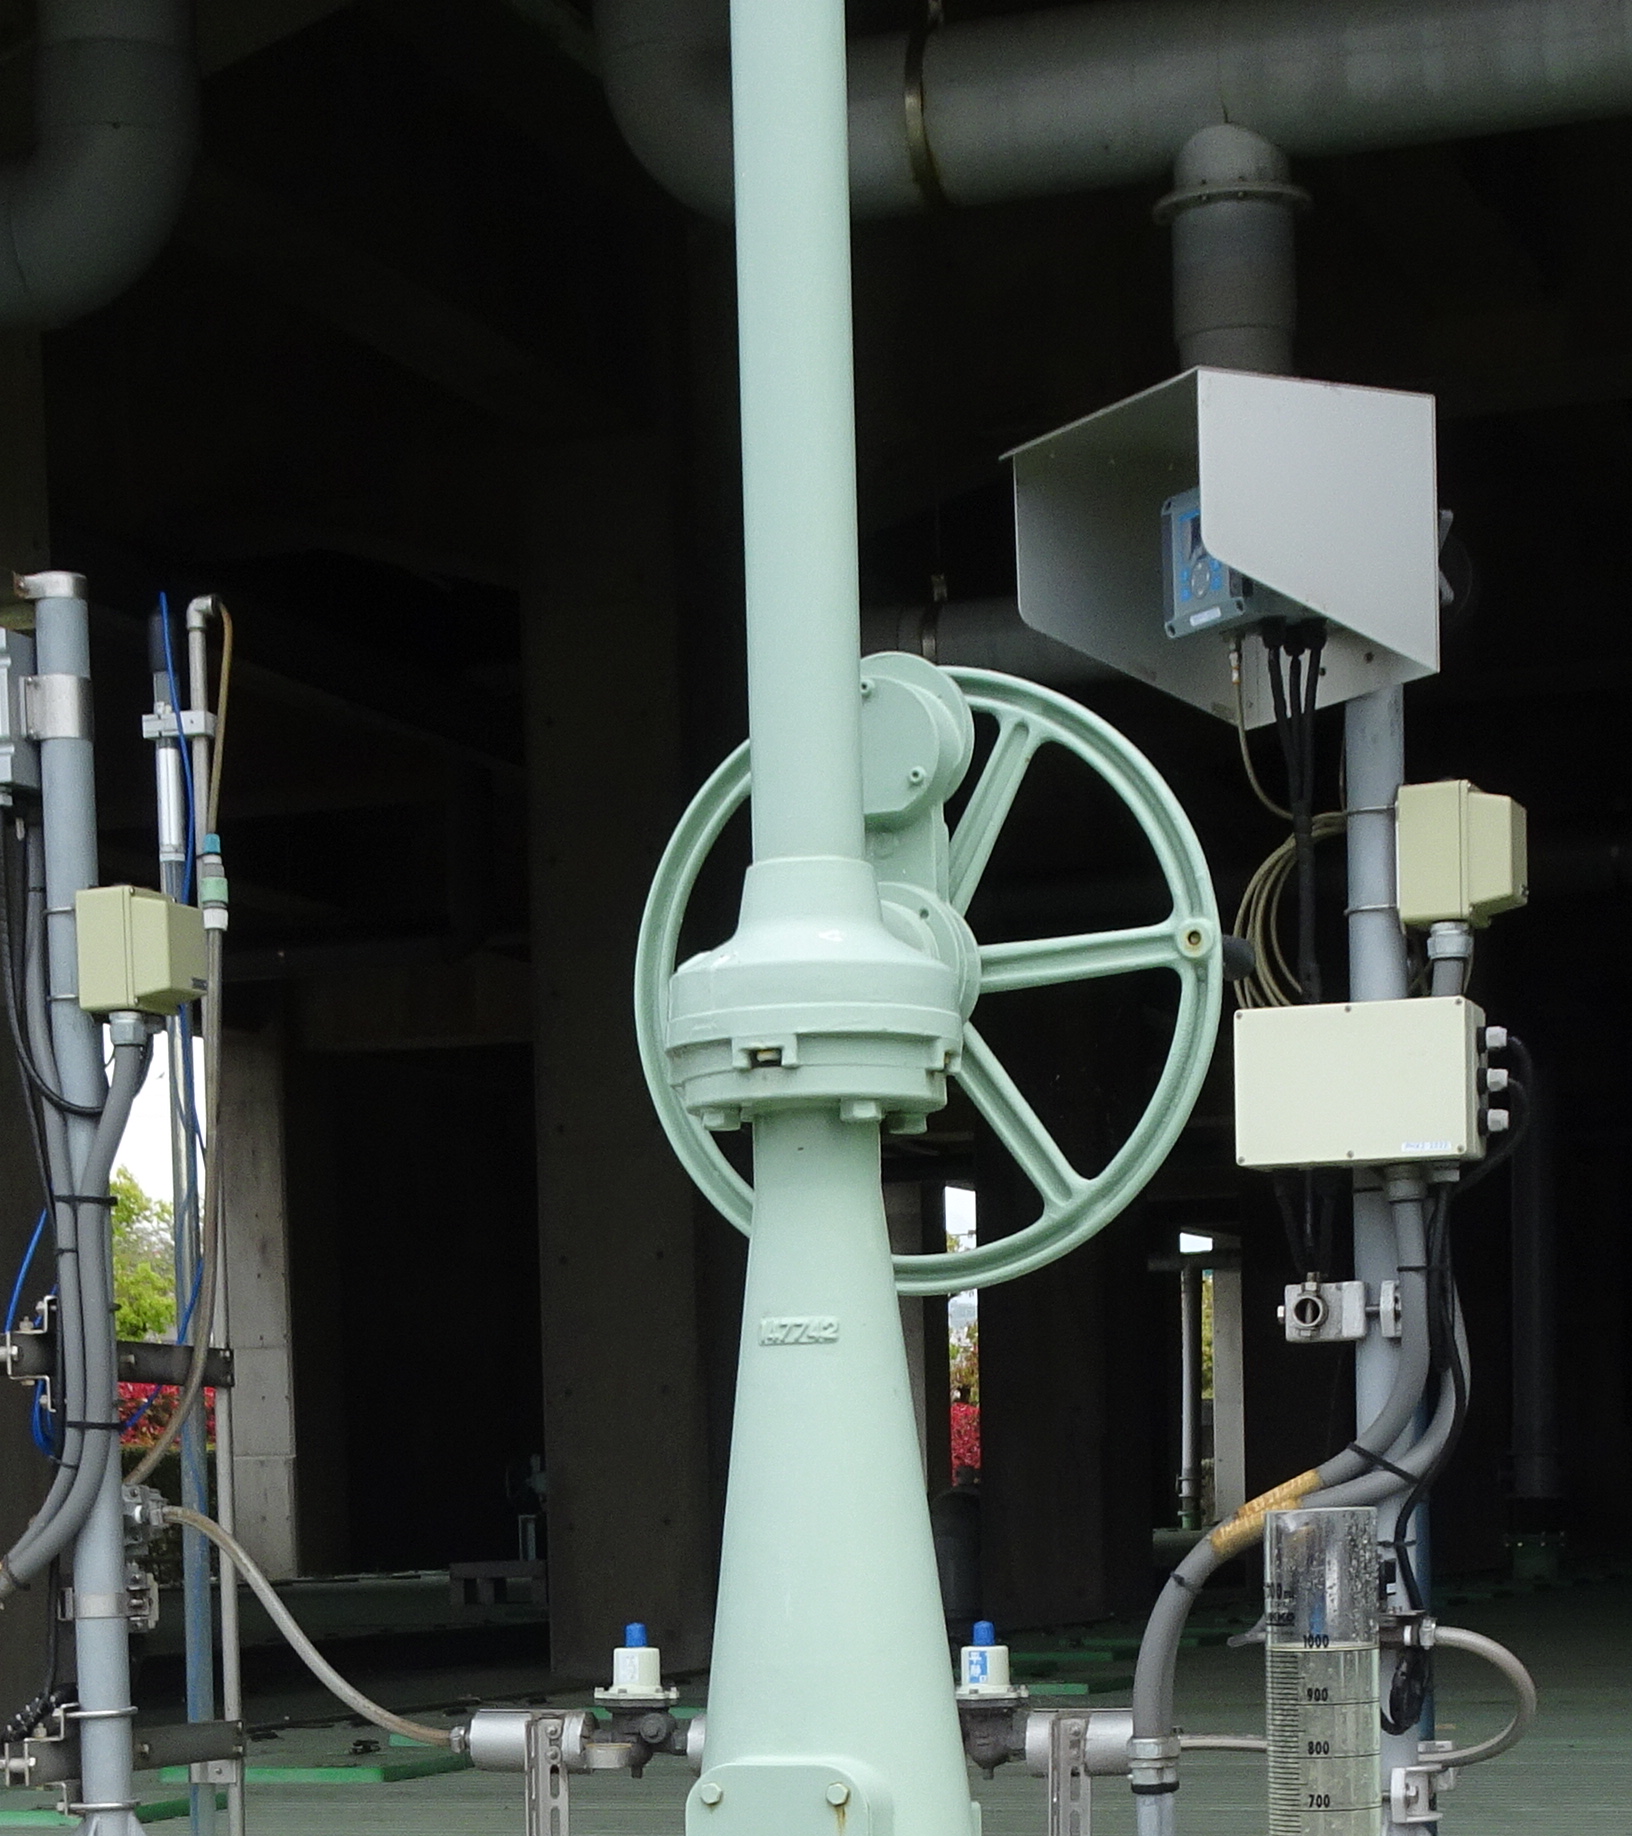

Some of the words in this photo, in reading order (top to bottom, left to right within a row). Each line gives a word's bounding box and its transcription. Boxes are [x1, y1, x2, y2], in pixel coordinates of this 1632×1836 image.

[1303, 1634, 1330, 1648] 1000
[1307, 1687, 1329, 1701] 900
[1308, 1741, 1330, 1755] 800
[1308, 1794, 1331, 1808] 700
